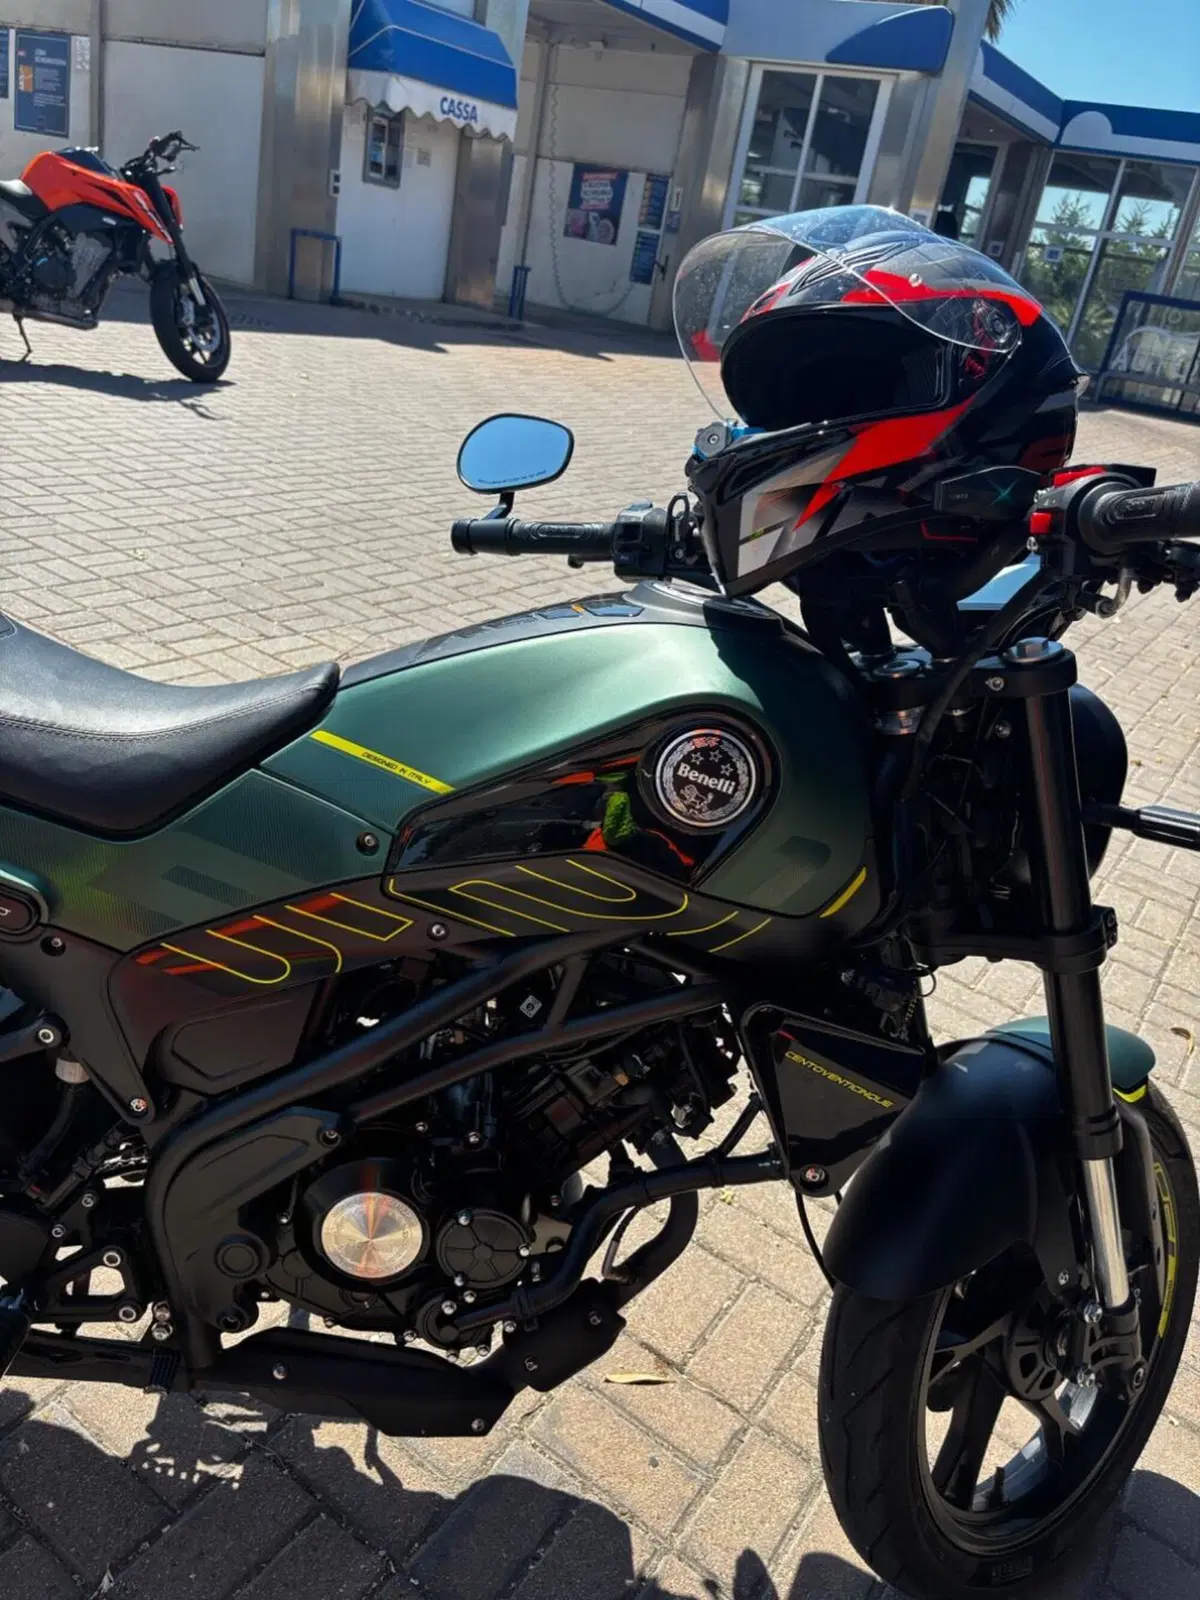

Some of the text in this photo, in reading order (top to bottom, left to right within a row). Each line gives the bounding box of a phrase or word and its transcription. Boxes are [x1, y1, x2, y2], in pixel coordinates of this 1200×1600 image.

[440, 96, 478, 124] CASSA
[362, 751, 398, 770] DESIGNED
[408, 772, 432, 784] ITALY
[676, 762, 736, 795] Benelli
